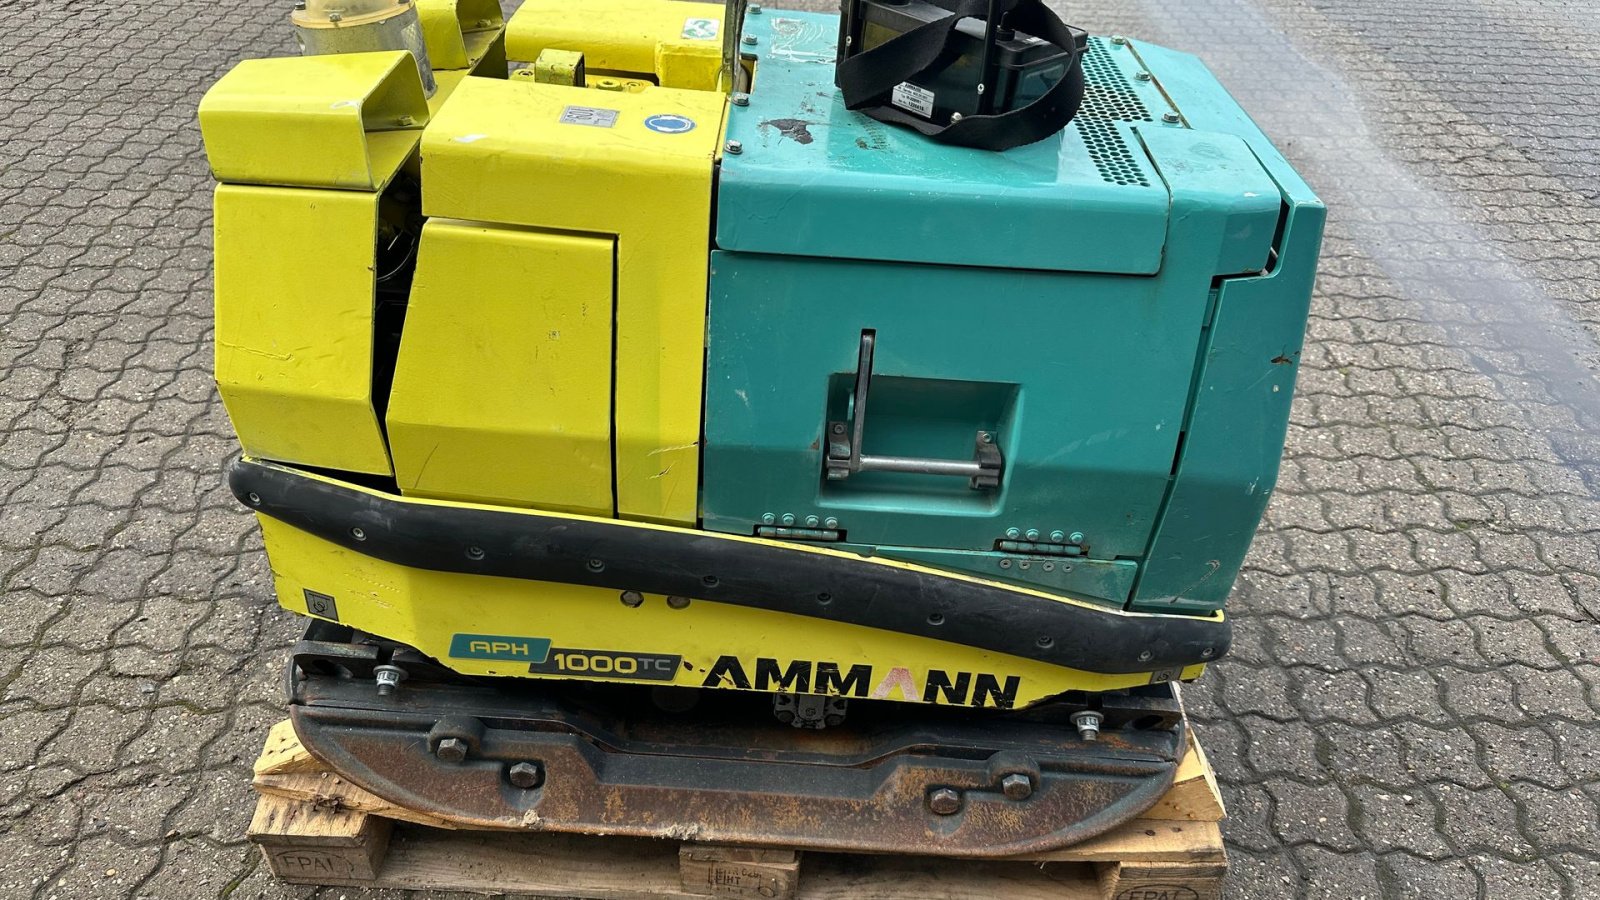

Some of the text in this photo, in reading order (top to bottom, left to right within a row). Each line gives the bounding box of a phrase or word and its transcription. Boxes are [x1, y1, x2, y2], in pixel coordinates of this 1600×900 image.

[470, 640, 671, 674] APH 1000TC
[702, 655, 1021, 710] AMMANN
